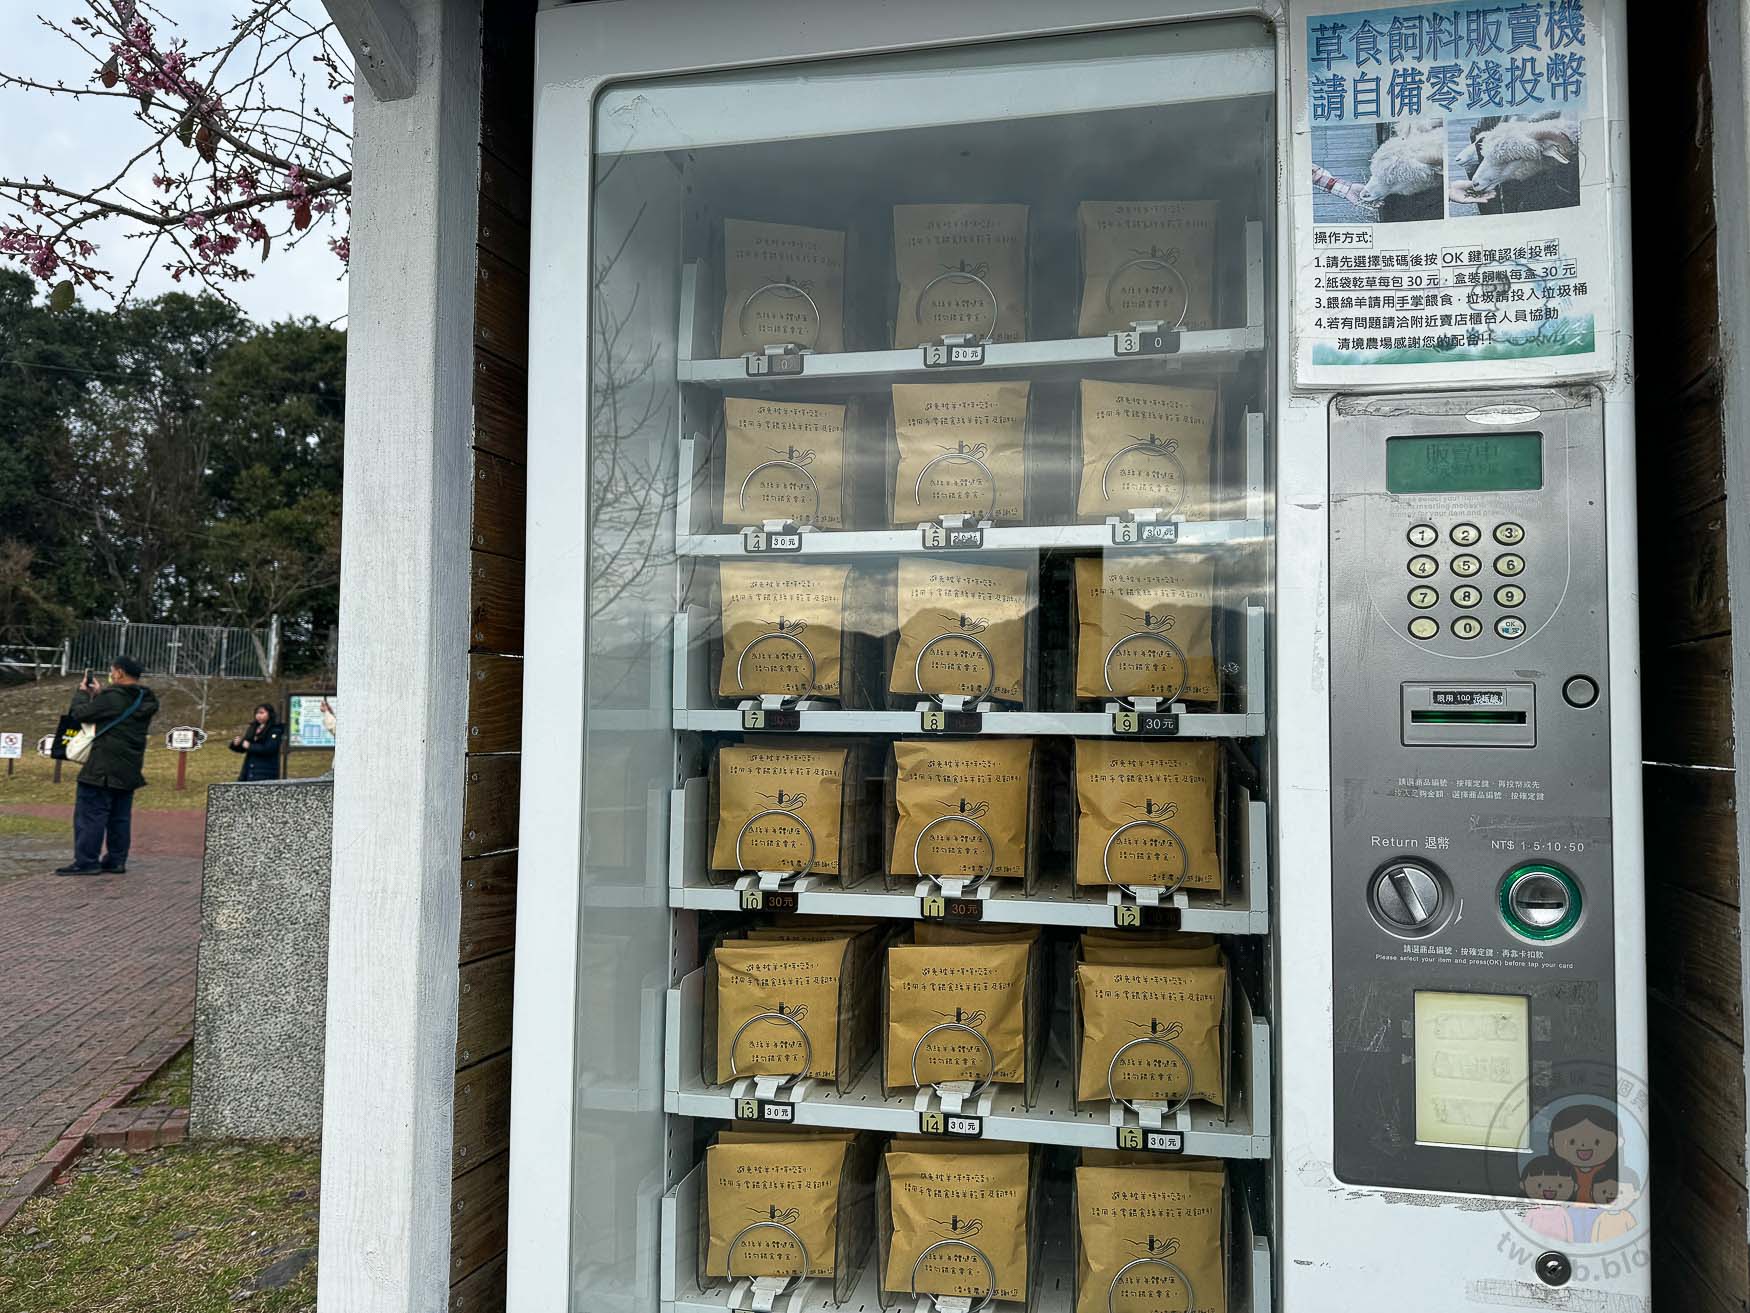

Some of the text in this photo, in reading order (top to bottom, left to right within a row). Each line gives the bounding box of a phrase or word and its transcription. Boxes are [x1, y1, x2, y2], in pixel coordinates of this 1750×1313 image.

[1311, 1, 1586, 71] 草食飼料販賣機
[1311, 52, 1586, 121] 請自備零錢投幣
[1442, 252, 1464, 264] OK
[1467, 243, 1558, 263] 鍵確認後投幣
[1407, 276, 1422, 287] 30
[1542, 267, 1558, 278] 30
[1563, 263, 1576, 276] 元
[1314, 307, 1559, 330] 4.若有問題請洽附近賣店櫃台人員協助
[955, 350, 979, 359] 30元
[1418, 530, 1425, 541] 1
[1461, 530, 1469, 541] 2
[1504, 528, 1513, 538] 3
[773, 537, 796, 546] 30元
[1419, 562, 1426, 573] 4
[1462, 561, 1470, 571] 5
[1506, 560, 1515, 570] 6
[1420, 592, 1428, 603] 7
[1462, 591, 1471, 602] 8
[1505, 591, 1514, 602] 9
[1463, 623, 1472, 633] 0
[1146, 718, 1174, 729] 30元
[1371, 836, 1450, 849] Return 退幣
[1491, 840, 1515, 850] NT$
[768, 896, 793, 907] 30元
[951, 903, 977, 914] 30元
[766, 1107, 788, 1117] 30元
[950, 1121, 975, 1131] 30元
[1151, 1137, 1177, 1147] 30元
